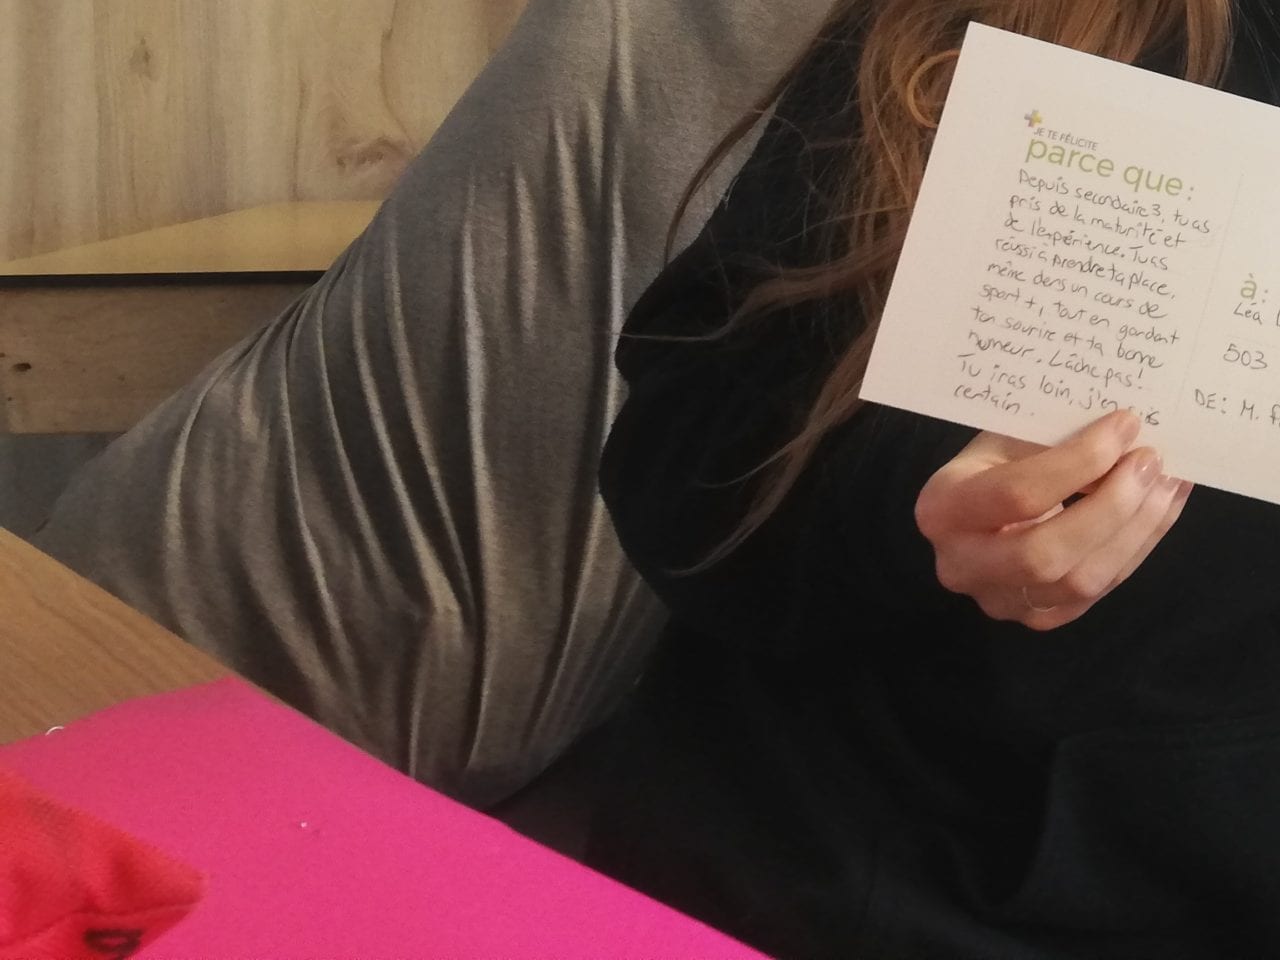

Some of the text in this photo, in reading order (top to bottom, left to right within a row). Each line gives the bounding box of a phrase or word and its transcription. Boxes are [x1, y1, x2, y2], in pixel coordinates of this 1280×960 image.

[1047, 130, 1058, 140] TE
[1025, 138, 1114, 177] parce
[1019, 168, 1069, 195] Depuis
[1004, 213, 1024, 232] de
[1010, 196, 1187, 248] pris de la maturité et
[995, 236, 1038, 259] réussi
[1053, 255, 1105, 278] prendre
[1128, 272, 1176, 299] place,
[987, 262, 1168, 319] même dans un cours de
[980, 284, 1021, 302] sport
[1053, 301, 1085, 321] tout
[1089, 314, 1110, 326] en
[1119, 325, 1179, 344] gardant
[1234, 302, 1263, 325] Léa
[971, 306, 1164, 369] ton sourire et ta bonne
[1223, 343, 1268, 370] 503
[958, 353, 981, 376] Tu
[991, 364, 1026, 389] iras
[1039, 376, 1073, 405] loin,
[1240, 400, 1259, 422] M.
